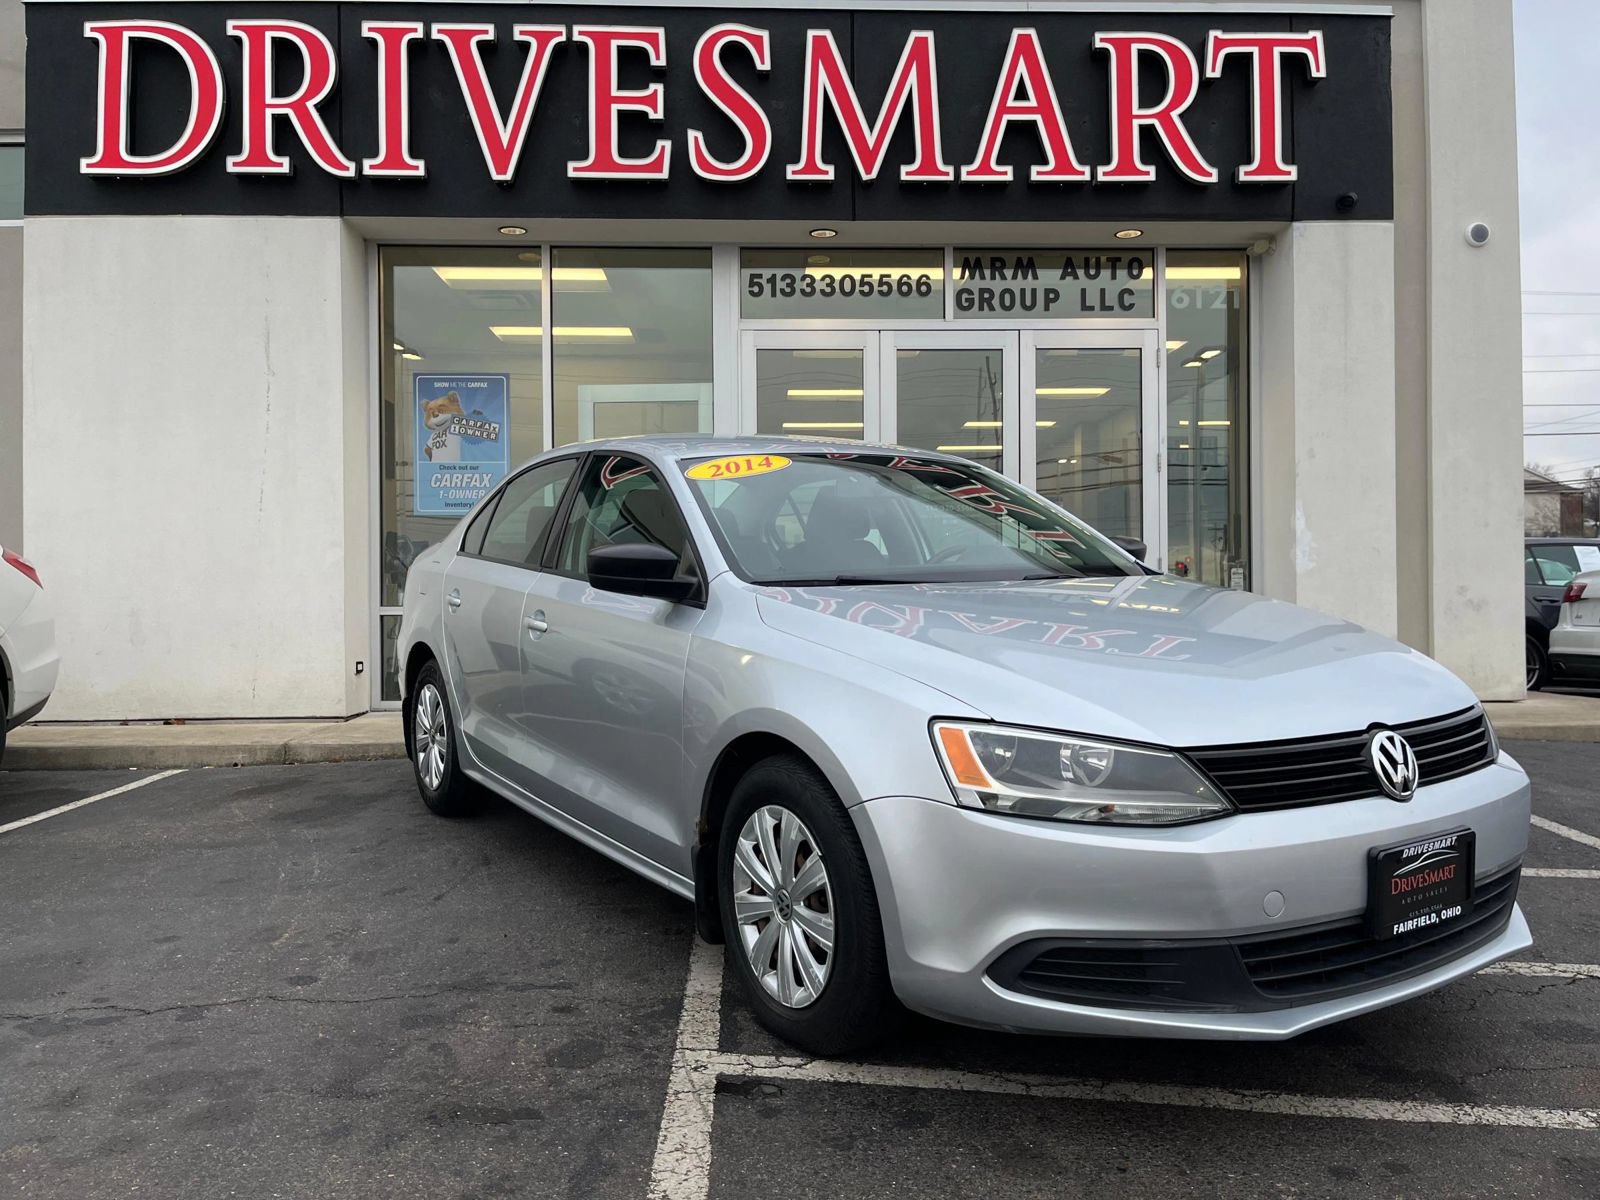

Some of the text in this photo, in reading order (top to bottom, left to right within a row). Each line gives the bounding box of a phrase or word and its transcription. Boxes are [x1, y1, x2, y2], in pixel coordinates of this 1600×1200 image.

[80, 19, 1326, 184] DRIVESMART
[960, 256, 1144, 280] MRM AUTO
[748, 273, 932, 298] 5133305566
[955, 287, 1136, 312] GROUP LLC
[1171, 286, 1240, 310] 6121
[453, 417, 500, 433] CARFAX
[459, 427, 497, 440] OWNER
[432, 439, 448, 449] FOX
[708, 456, 773, 477] 2014
[431, 473, 492, 488] CARFAX
[1402, 836, 1457, 858] DRIVESMART
[1393, 913, 1439, 935] FAIRFIELD,
[1441, 905, 1462, 919] OHIO
